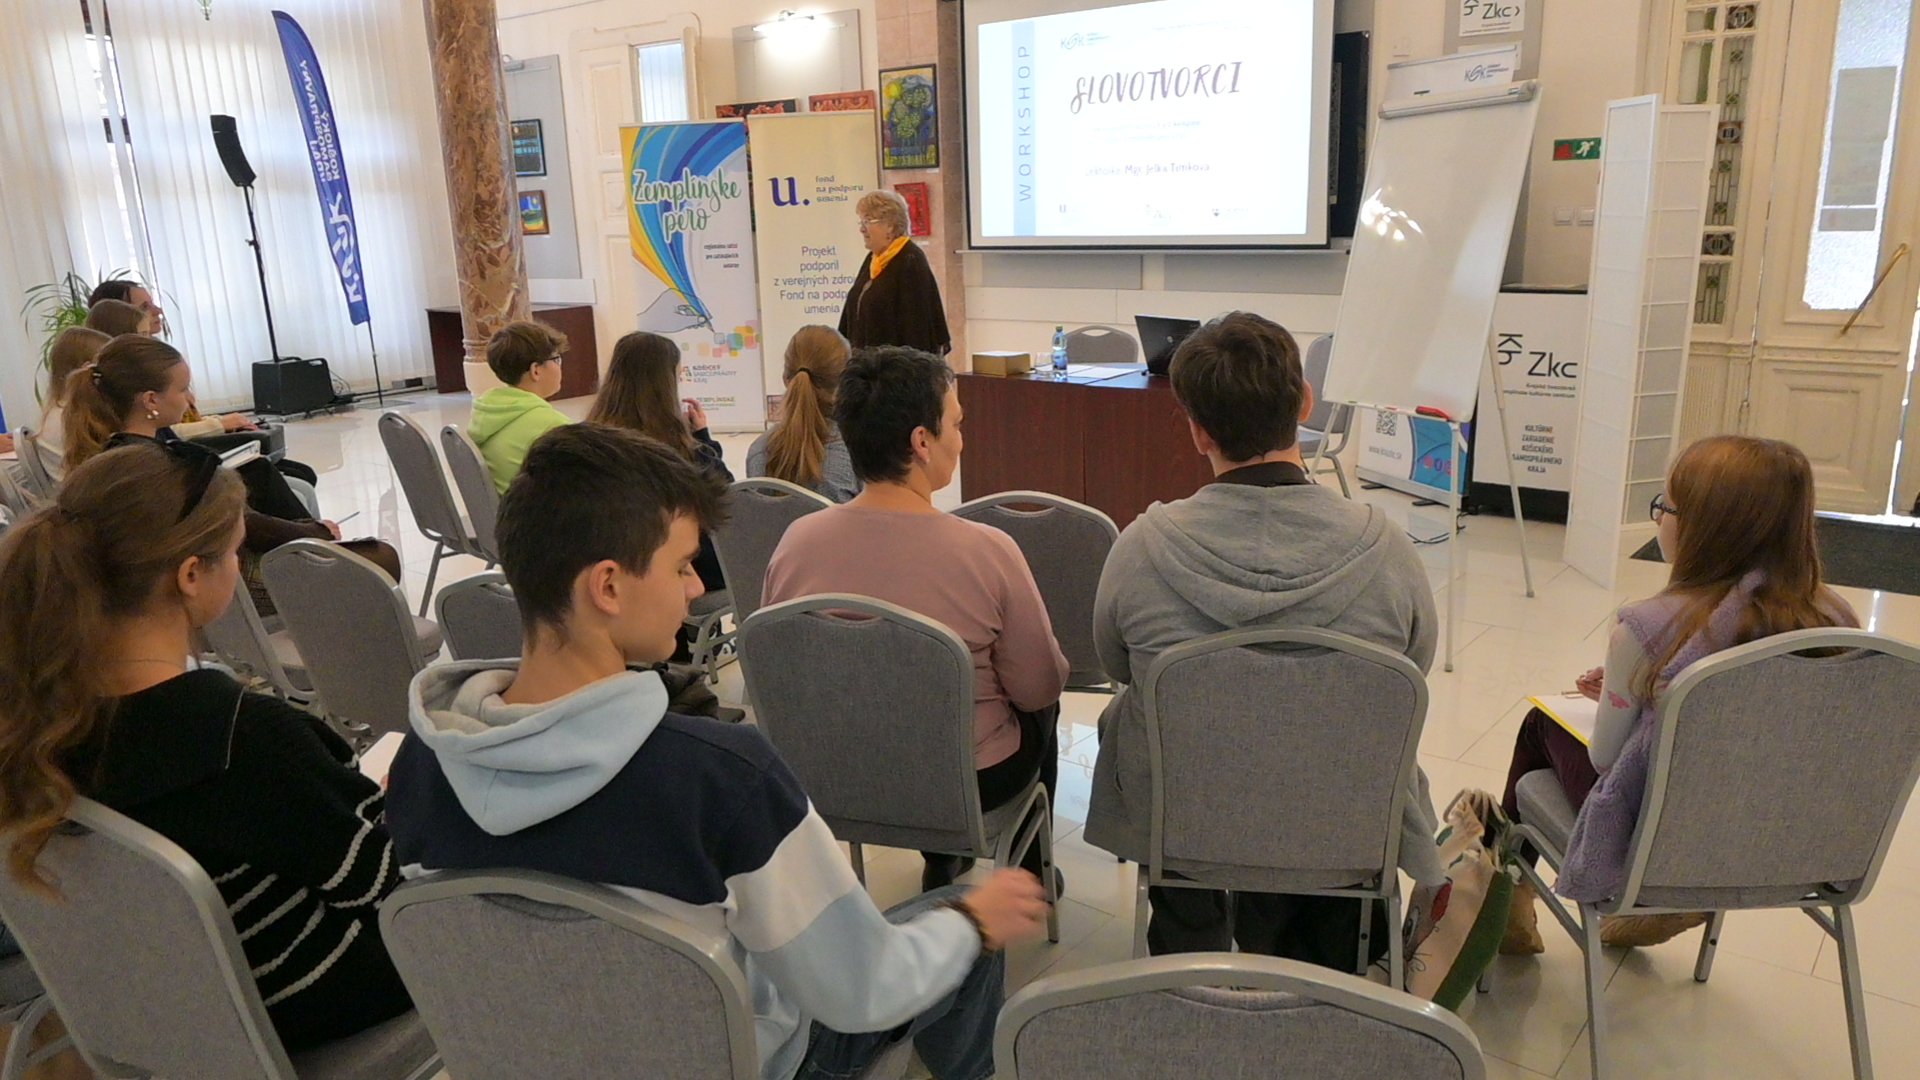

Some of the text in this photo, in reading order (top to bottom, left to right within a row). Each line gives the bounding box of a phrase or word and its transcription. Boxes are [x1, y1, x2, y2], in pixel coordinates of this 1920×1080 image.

[1482, 3, 1512, 19] Zkc
[1070, 61, 1243, 115] SLOVOTVORCI
[1017, 46, 1032, 202] WORKSHOP
[633, 167, 742, 213] Zemplínske
[801, 245, 836, 259] Projekt
[800, 260, 840, 274] podporil
[773, 278, 780, 287] z
[782, 274, 830, 289] verejných
[780, 289, 805, 300] Fond
[807, 292, 820, 300] na
[804, 304, 841, 315] umenia
[1527, 351, 1578, 378] Zkc
